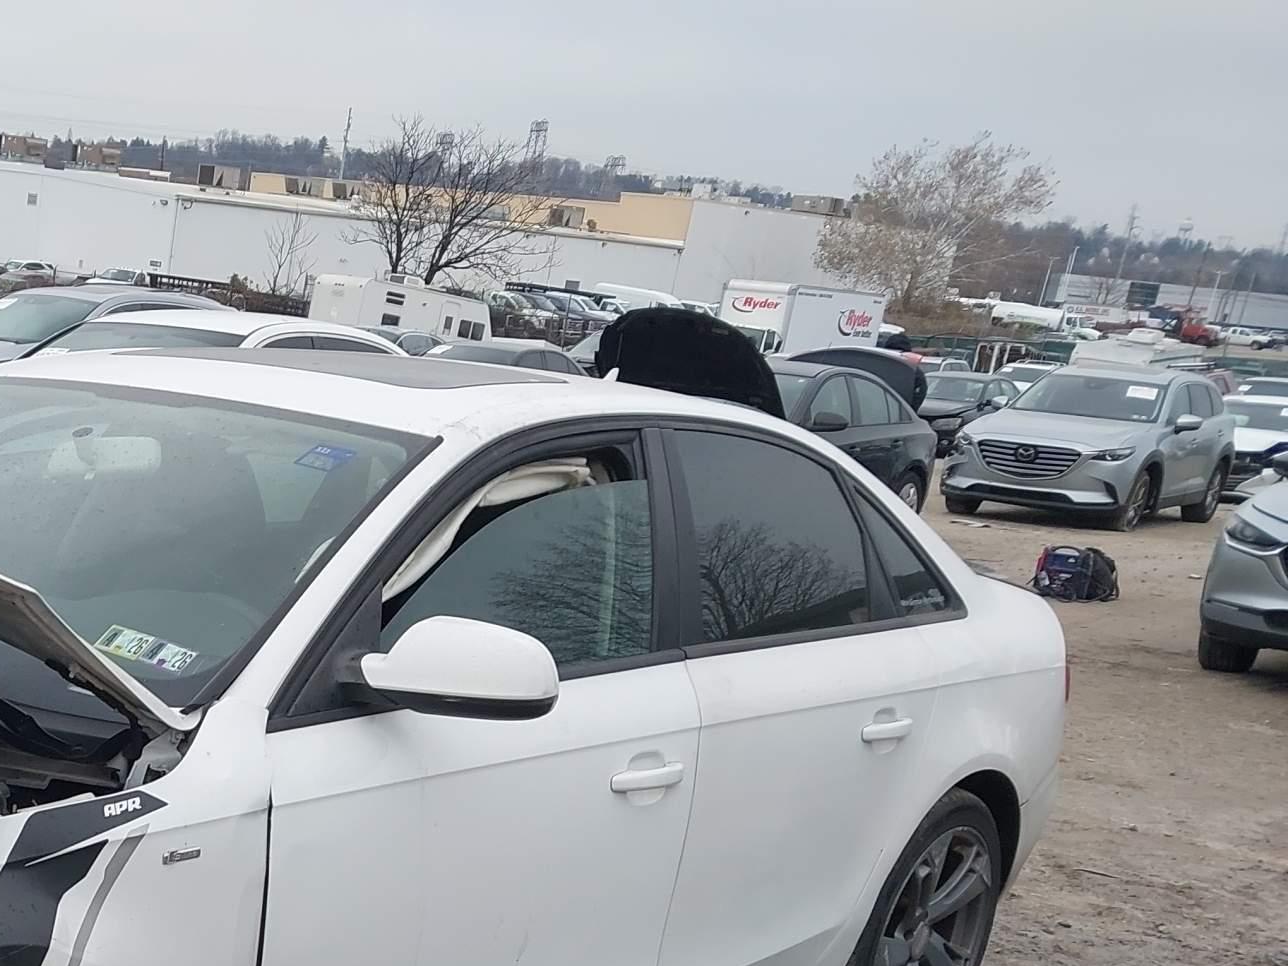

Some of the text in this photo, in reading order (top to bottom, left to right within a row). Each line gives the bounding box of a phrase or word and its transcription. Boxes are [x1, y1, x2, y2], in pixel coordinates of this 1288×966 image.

[743, 296, 781, 310] Ryder
[846, 309, 873, 329] Ryder
[103, 796, 142, 818] APR
